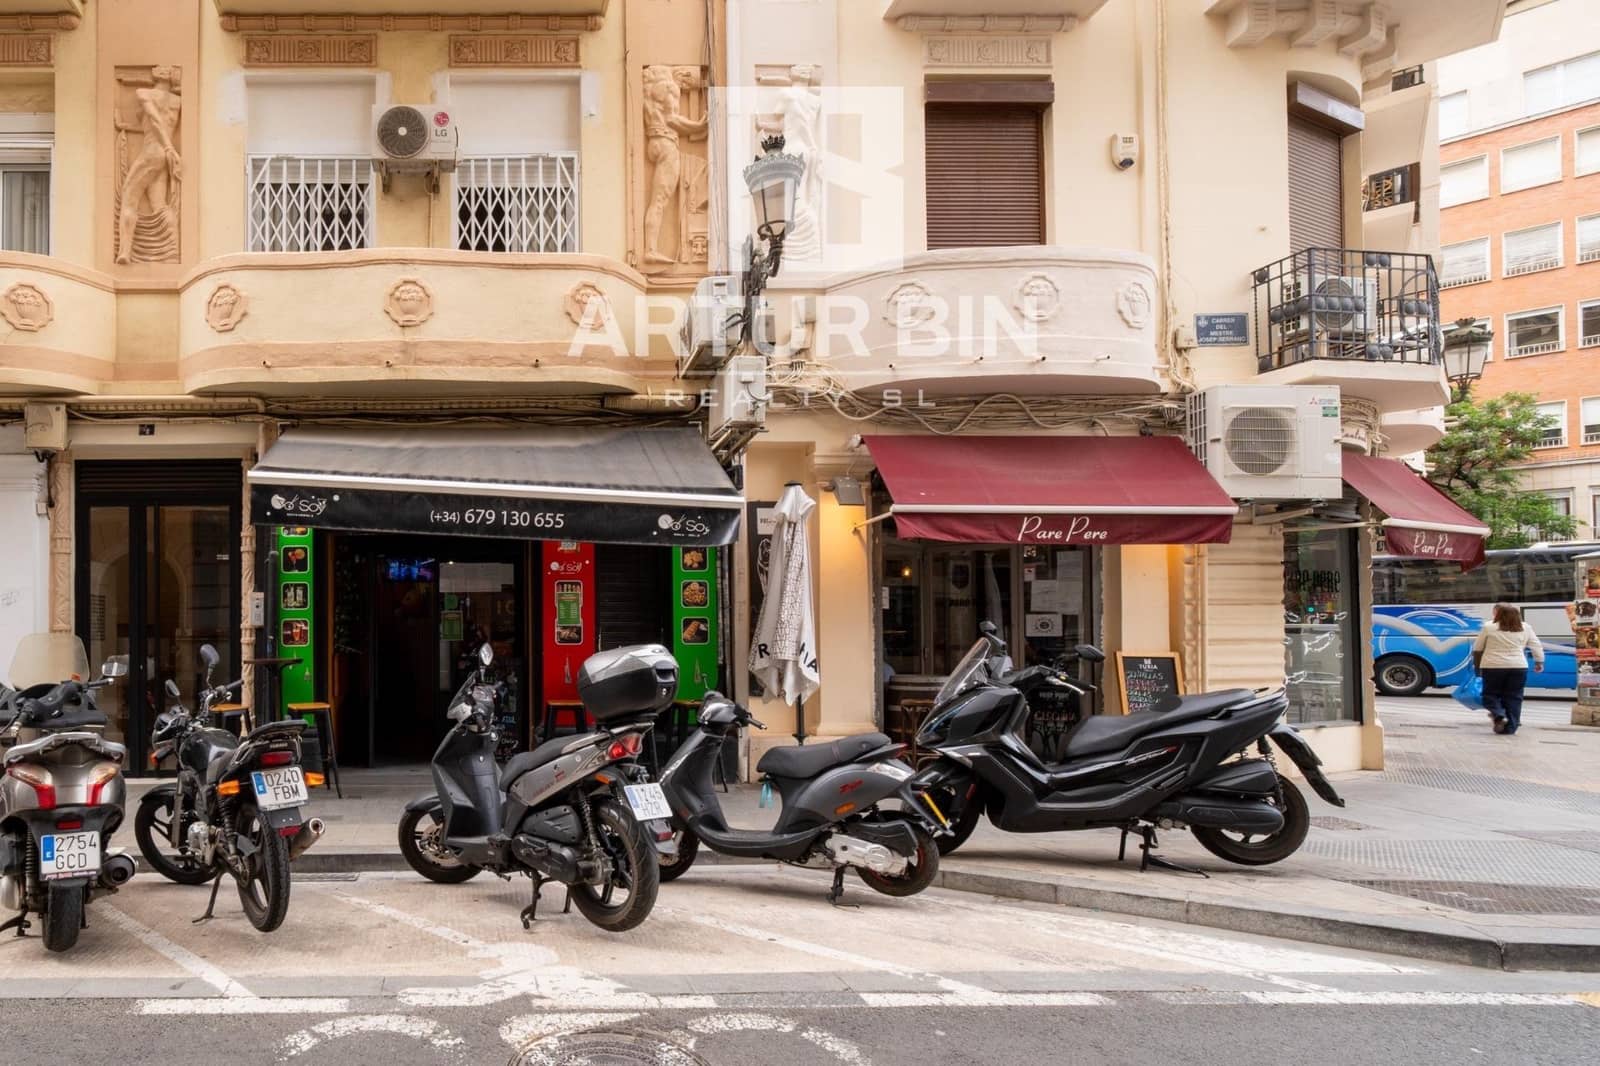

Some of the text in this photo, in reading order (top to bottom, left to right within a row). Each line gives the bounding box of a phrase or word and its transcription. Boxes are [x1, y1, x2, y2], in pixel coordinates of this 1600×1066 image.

[435, 129, 448, 137] LG
[430, 508, 565, 528] (+34) 679 130 655
[1017, 515, 1108, 542] Pare Pere
[265, 770, 299, 787] 0240
[273, 784, 301, 801] FBM
[55, 833, 97, 852] 2754
[55, 852, 87, 870] GCD
